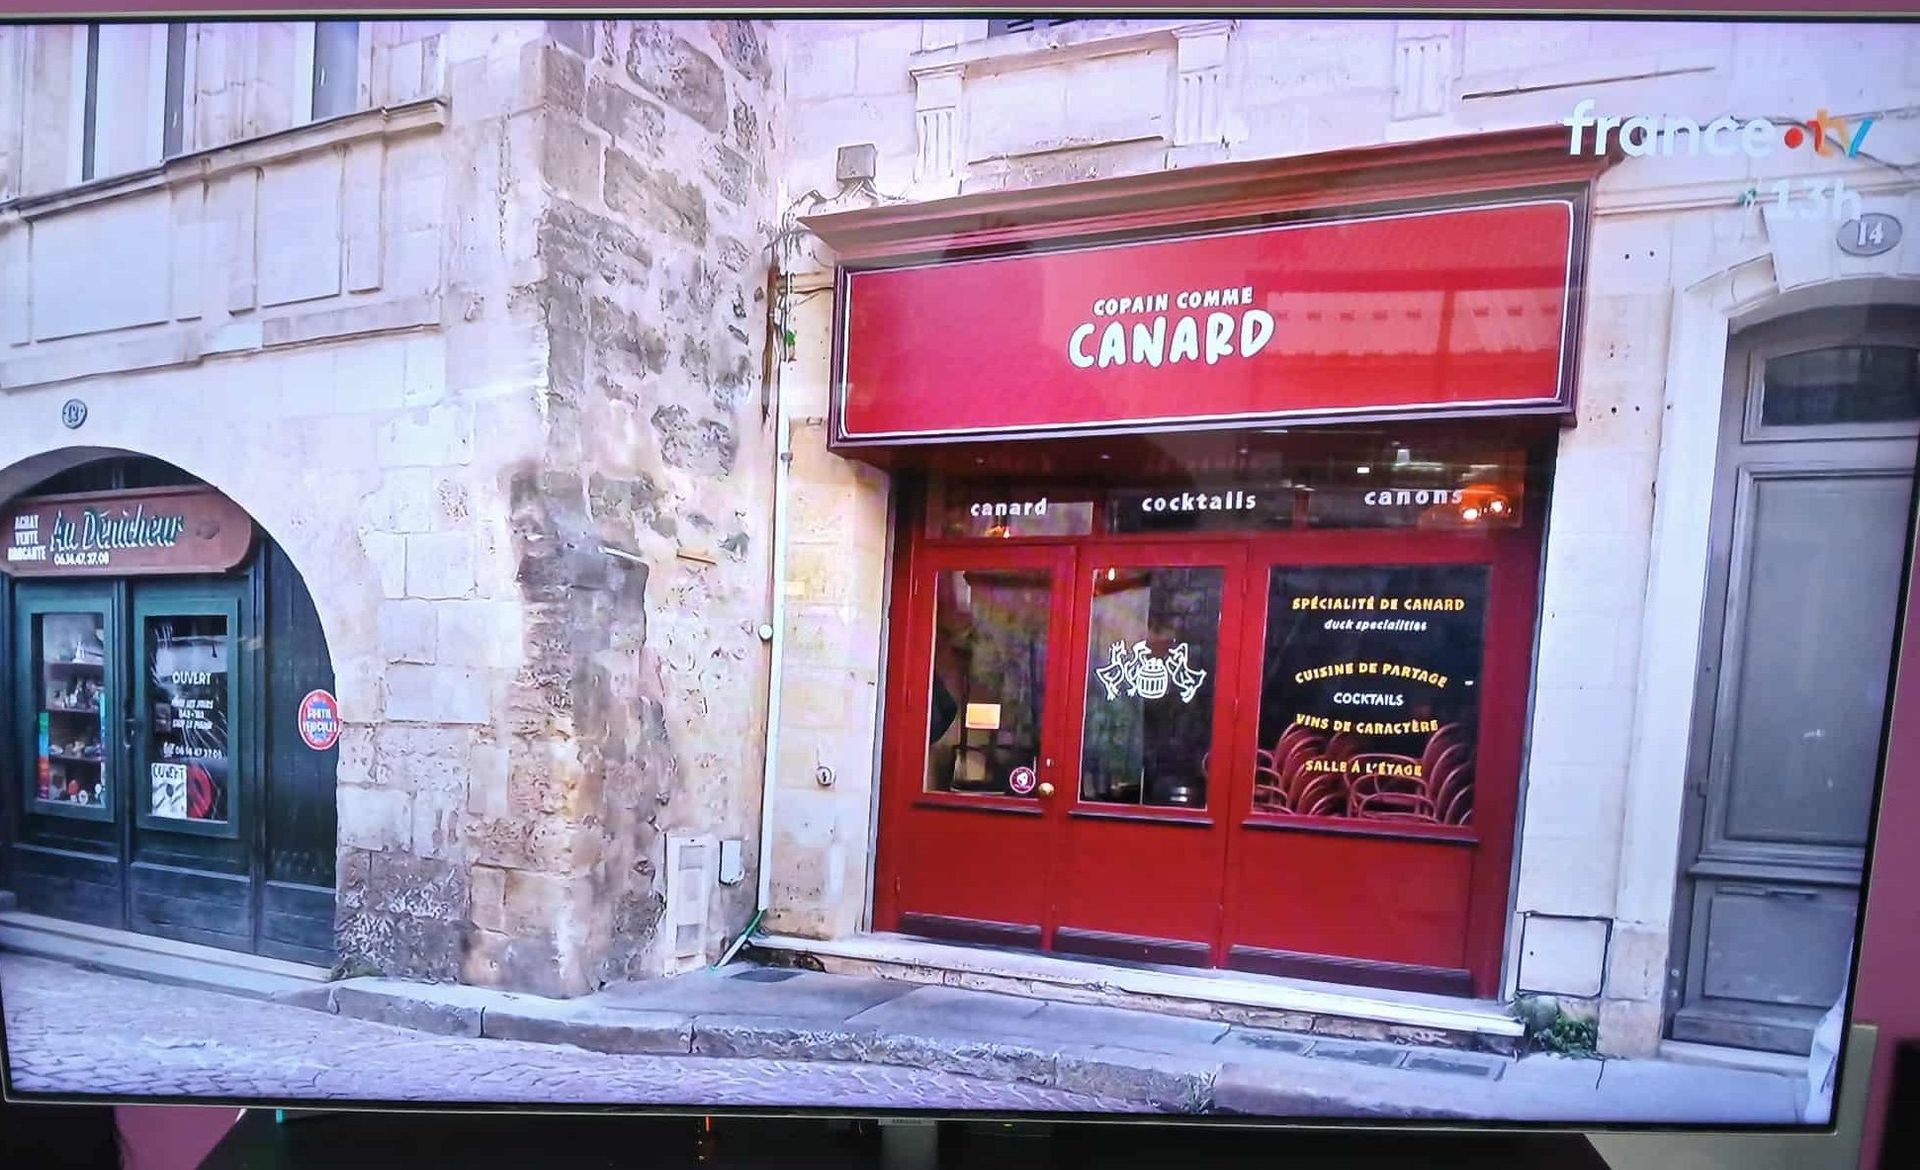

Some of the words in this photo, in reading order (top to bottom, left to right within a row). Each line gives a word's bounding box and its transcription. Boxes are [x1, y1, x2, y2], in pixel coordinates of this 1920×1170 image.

[1763, 178, 1863, 220] 13h
[1857, 222, 1885, 247] 14
[1092, 293, 1169, 316] COPAIN
[1176, 286, 1254, 309] COMME
[1068, 309, 1276, 368] CANARD
[970, 497, 1048, 517] canard
[1141, 491, 1257, 512] cocktails
[1364, 489, 1463, 506] canons
[14, 530, 39, 545] VENTE
[50, 509, 79, 552] Au
[82, 503, 184, 551] Dénicheur
[1292, 595, 1375, 611] SPÉCIALITÉ
[1380, 598, 1399, 610] DE
[1403, 598, 1466, 611] CANARD
[1324, 618, 1355, 631] duck
[172, 671, 213, 685] OUVERT
[1294, 662, 1354, 685] CUISINE
[1358, 662, 1378, 674] DE
[1382, 663, 1449, 689] PARTAGE
[1333, 692, 1405, 706] COCKTAILS
[1296, 713, 1329, 730] VINS
[1333, 720, 1352, 732] DE
[1356, 719, 1439, 735] CARACTÈRE
[1305, 760, 1347, 772] SALLE
